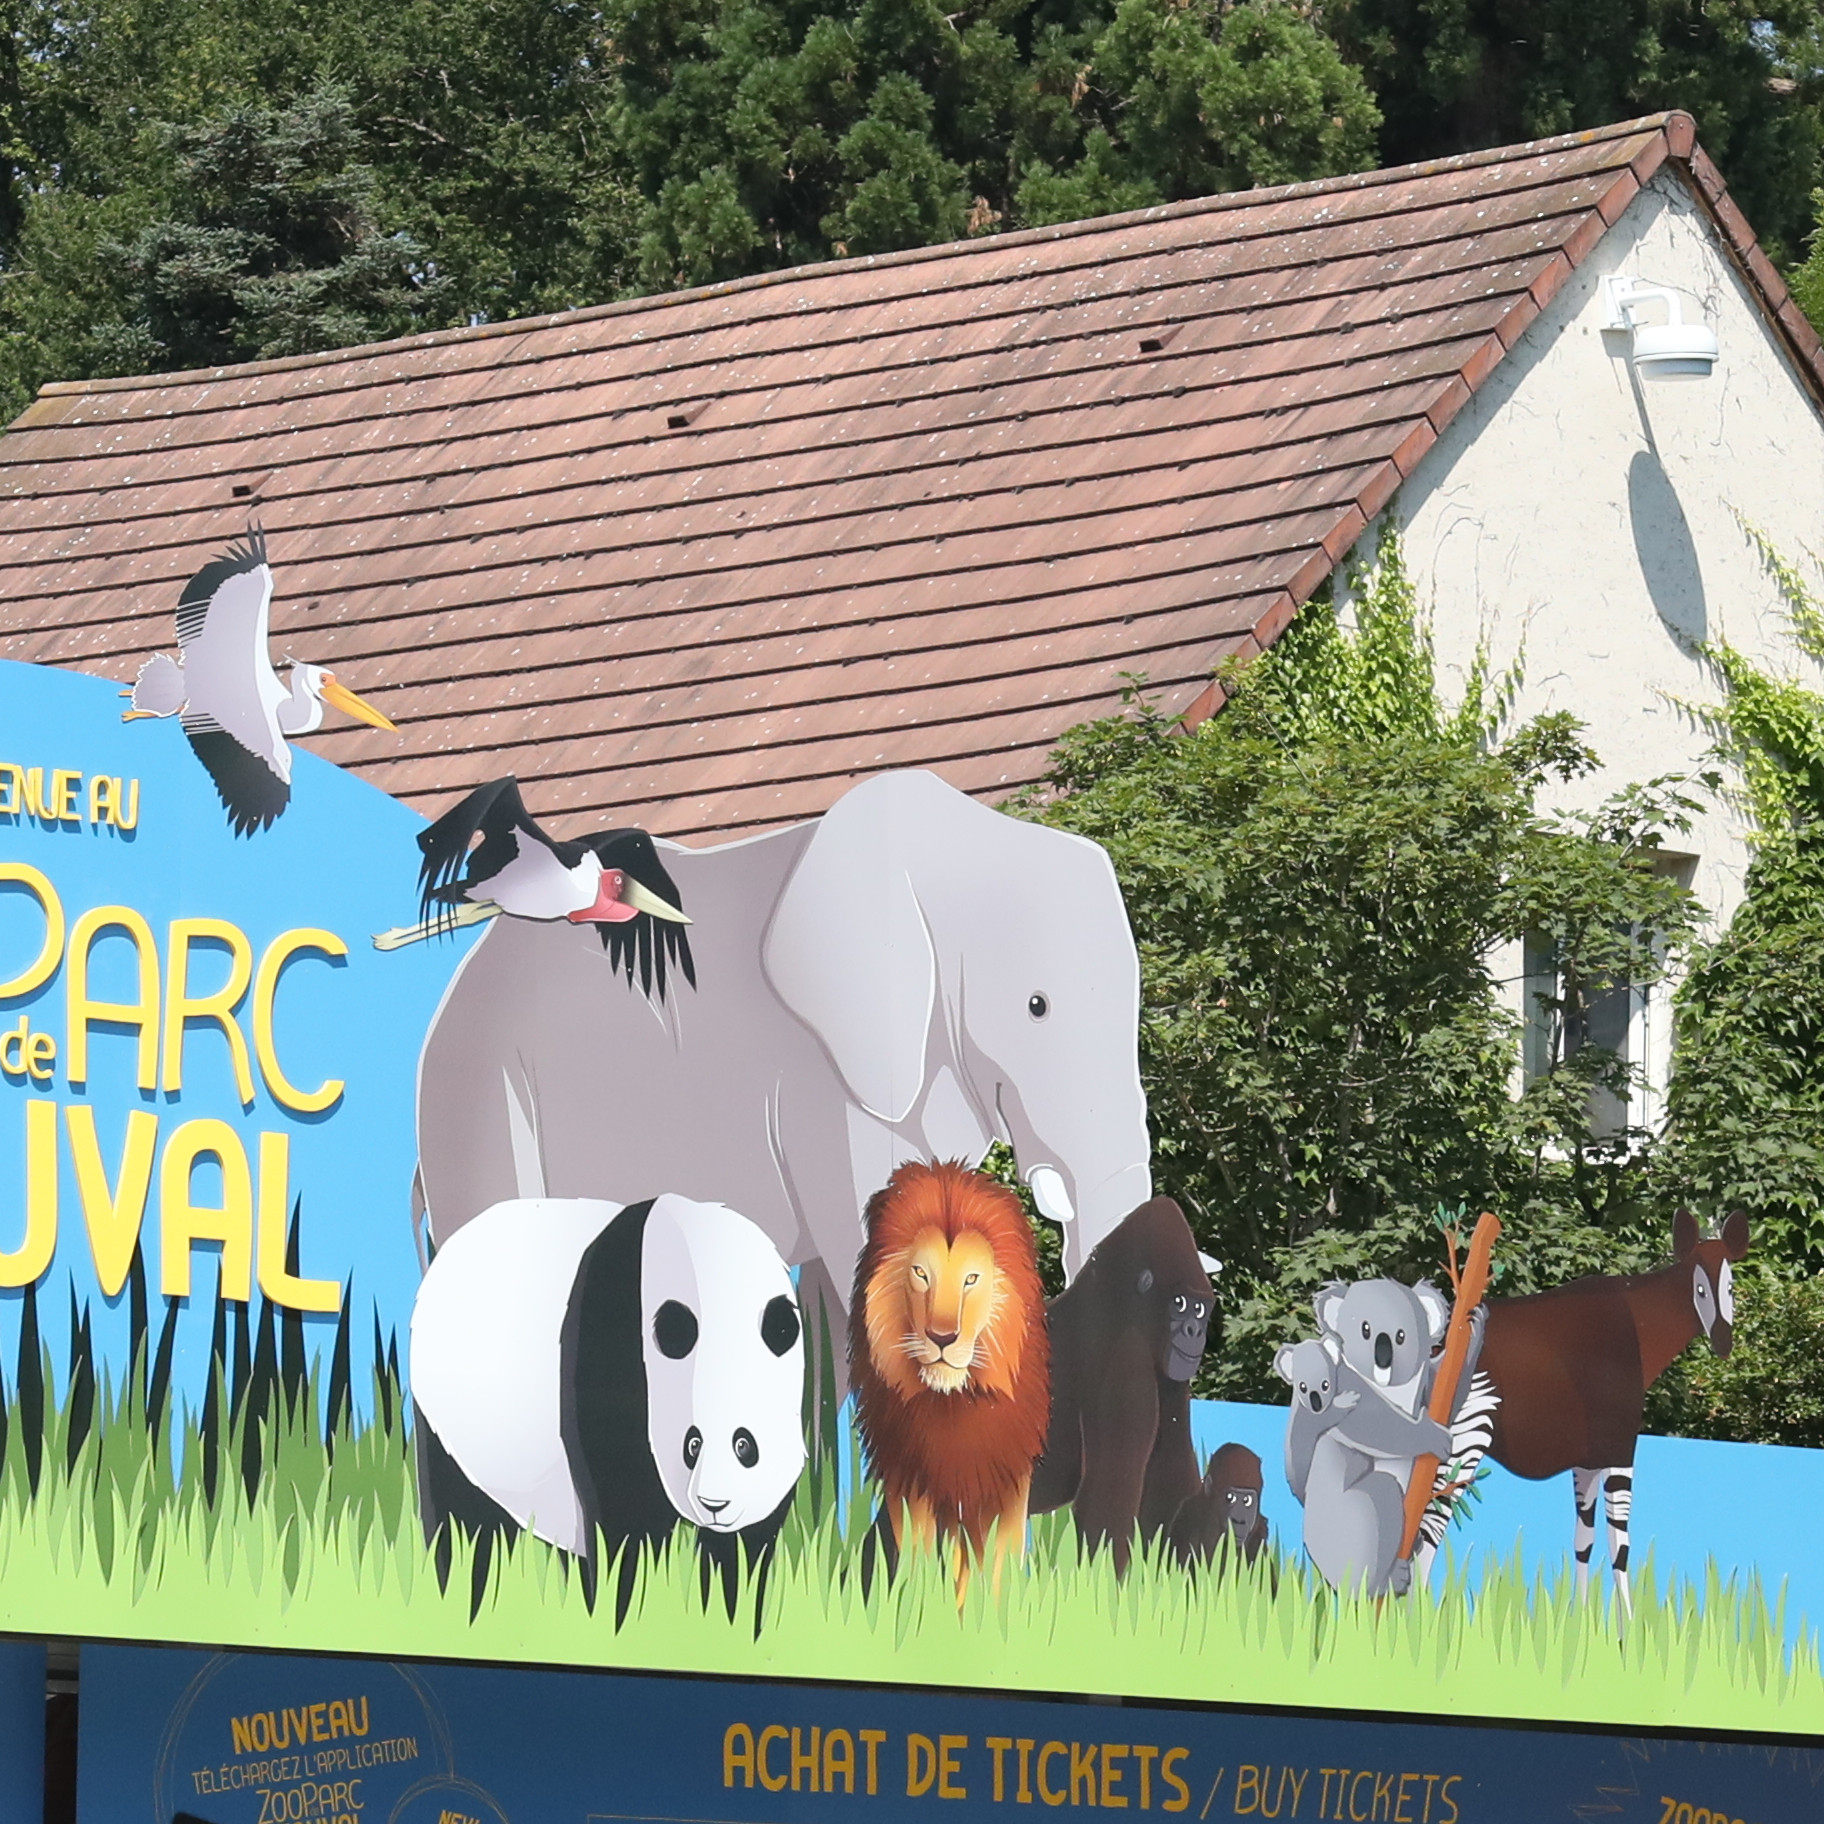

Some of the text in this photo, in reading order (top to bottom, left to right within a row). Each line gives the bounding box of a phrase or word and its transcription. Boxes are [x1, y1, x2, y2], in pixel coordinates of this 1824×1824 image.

[89, 774, 139, 831] AU
[230, 1696, 369, 1755] NOUVEAU
[191, 1737, 419, 1795] TÉLÉCHARGEZ L'APPLICATION
[722, 1722, 887, 1796] ACHAT
[906, 1732, 968, 1799] DE
[986, 1736, 1190, 1812] TICKETS
[1233, 1765, 1309, 1818] BUY
